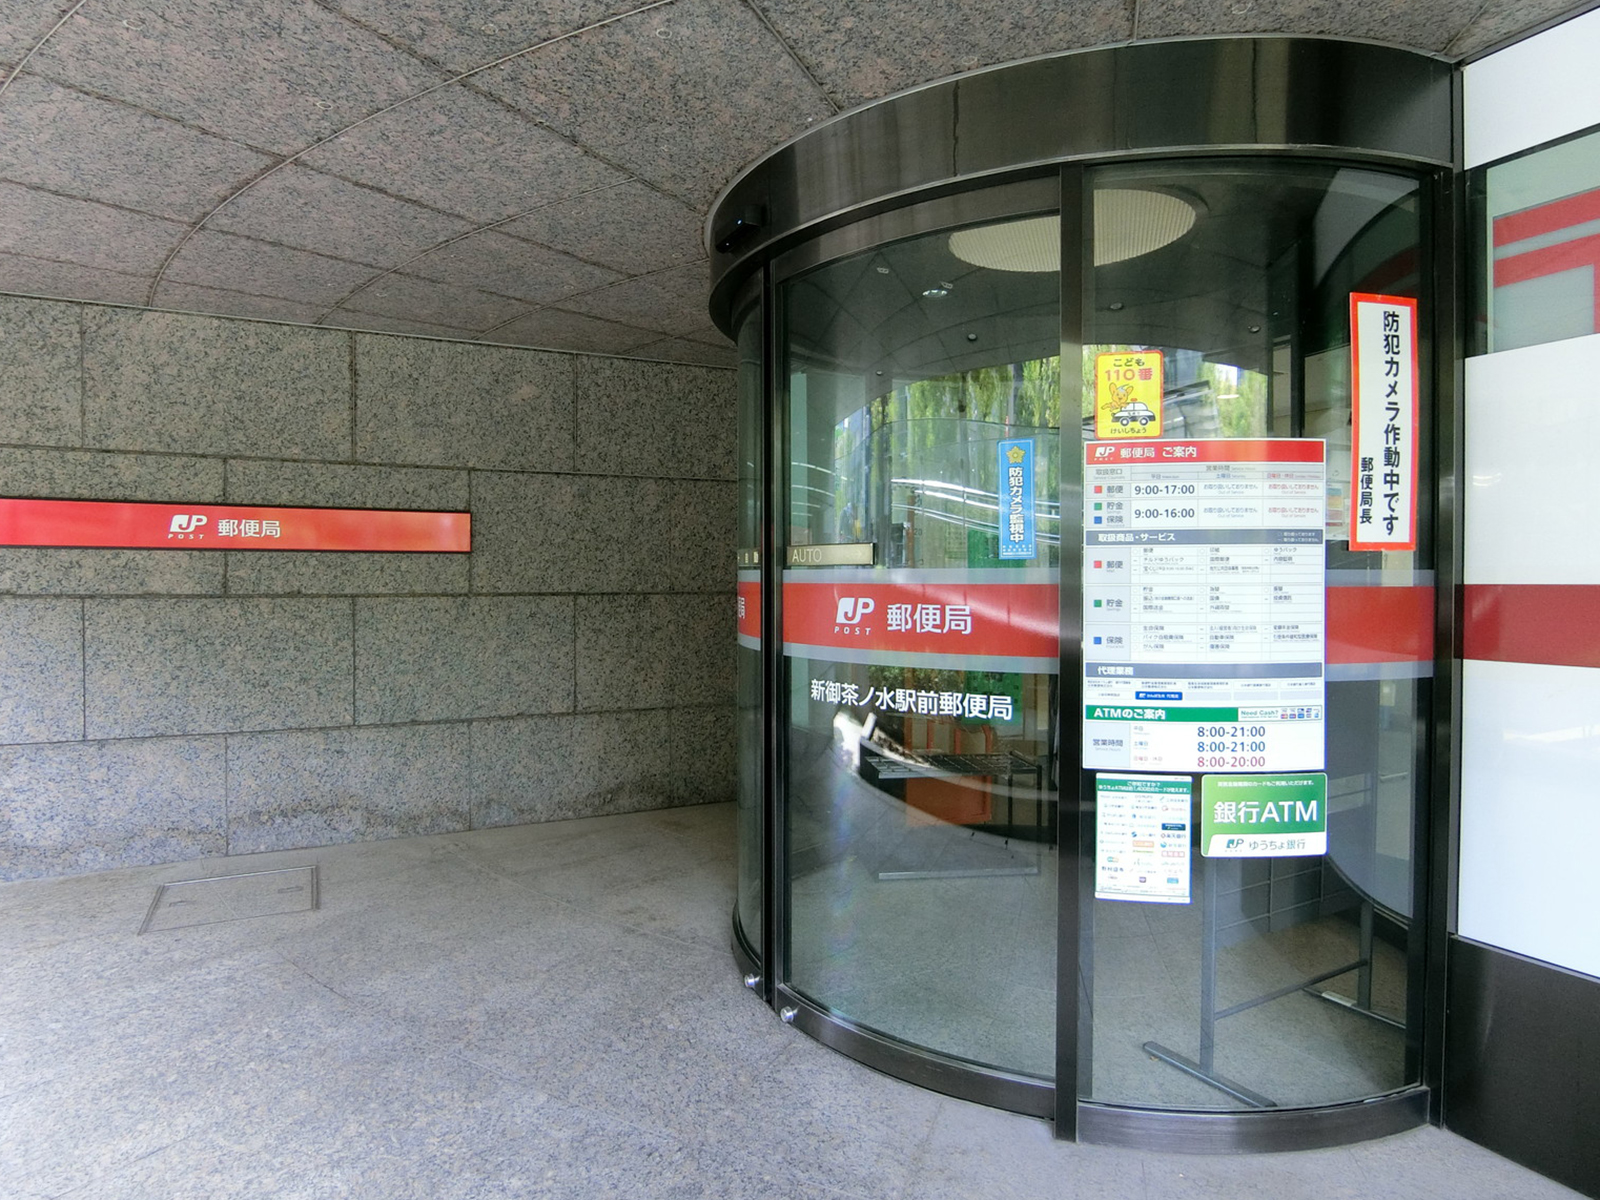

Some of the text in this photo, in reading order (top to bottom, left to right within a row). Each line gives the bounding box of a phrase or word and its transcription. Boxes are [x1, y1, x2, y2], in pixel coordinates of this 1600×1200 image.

[1113, 358, 1145, 367] こども
[1105, 368, 1153, 381] 110番
[1382, 311, 1400, 536] 防犯カメラ作動中です
[1095, 446, 1197, 458] JP 郵便局 ご案内
[1134, 485, 1195, 495] 9:00-17:00
[1359, 457, 1374, 524] 郵便局長
[1008, 467, 1024, 542] 防犯カメラ監視中
[1134, 508, 1195, 518] 9:00-16:00
[170, 514, 281, 538] JP 郵便局
[1098, 533, 1175, 542] 取扱商品・サービス
[792, 549, 822, 562] AUTO
[1106, 560, 1123, 569] 郵便
[1106, 599, 1123, 607] 貯金
[835, 597, 972, 634] JP 郵便局
[834, 626, 871, 635] POST
[1106, 637, 1123, 645] 保険
[811, 678, 1013, 720] 新御茶ノ水駅前郵便局
[1094, 708, 1166, 720] ATMのご案内
[1197, 726, 1265, 737] 8:00-21:00
[1197, 741, 1265, 752] 8:00-21:00
[1197, 756, 1265, 767] 8:00-20:00
[1213, 800, 1318, 823] 銀行ATM
[1226, 838, 1306, 850] JP ゆうちょ銀行
